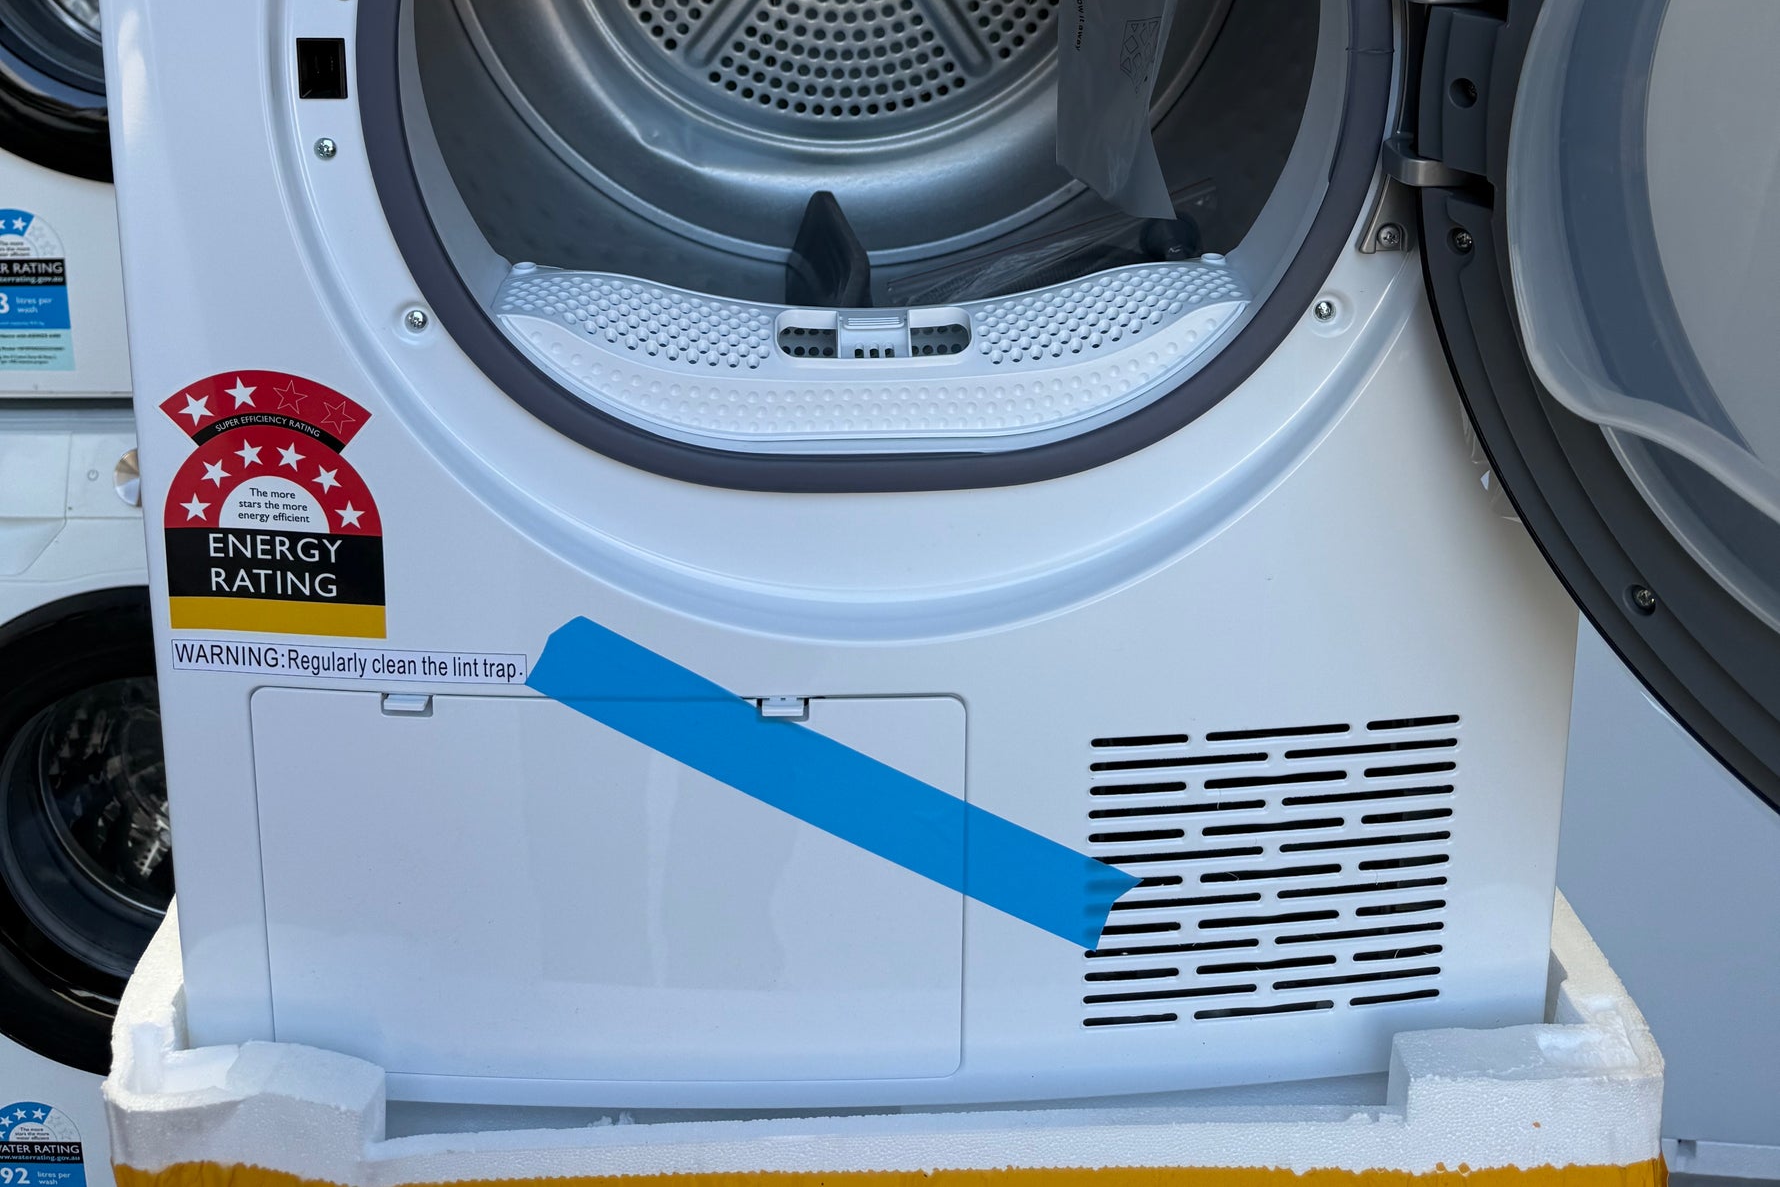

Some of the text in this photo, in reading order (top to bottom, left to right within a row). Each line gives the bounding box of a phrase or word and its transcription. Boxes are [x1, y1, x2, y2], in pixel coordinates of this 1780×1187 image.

[1075, 25, 1084, 51] away
[13, 262, 63, 274] RATING
[215, 415, 320, 437] SUPER EFFICIENCY RATING
[249, 487, 296, 499] The more
[238, 500, 308, 512] stars the more
[238, 511, 310, 523] energy efficient
[208, 532, 342, 564] ENERGY
[210, 567, 338, 598] RATING
[371, 651, 418, 676] clean
[421, 653, 448, 676] the
[452, 655, 479, 678] lint
[482, 657, 524, 680] trap.
[0, 1144, 80, 1154] ATER RATING
[0, 1167, 31, 1184] 92
